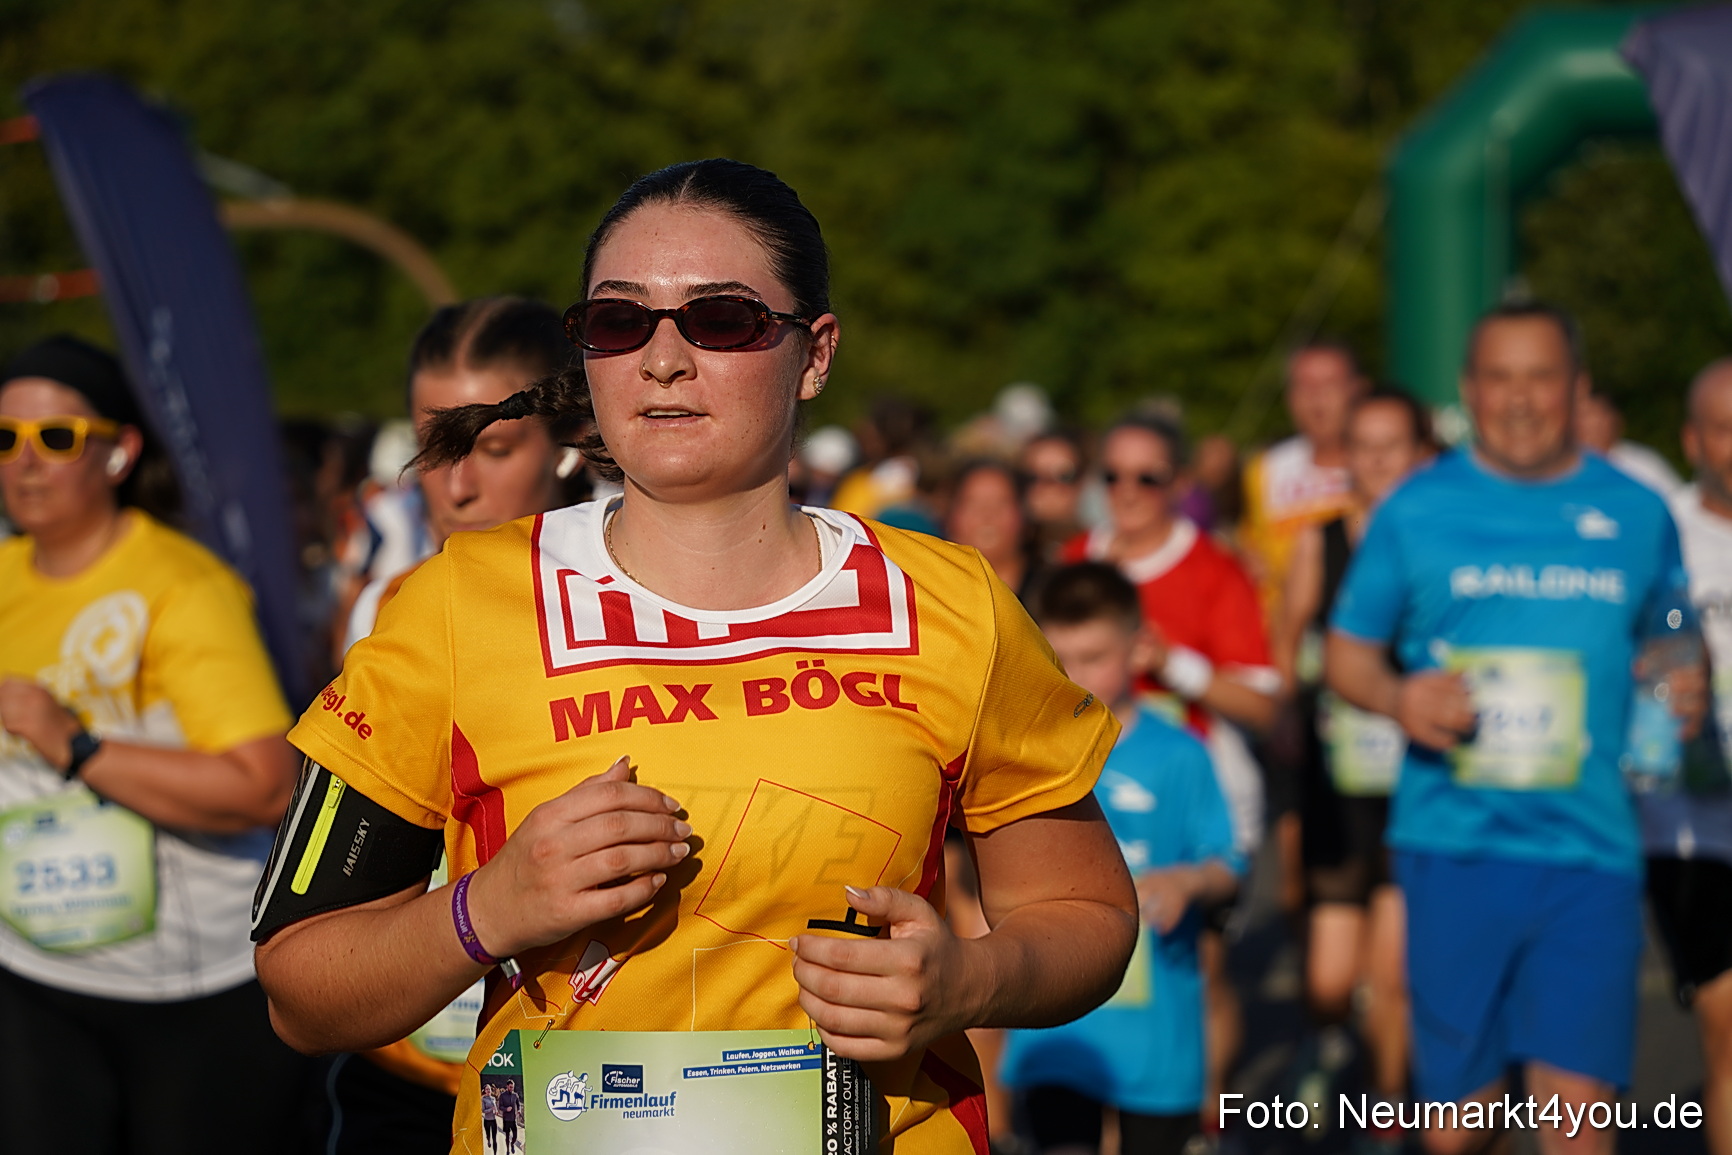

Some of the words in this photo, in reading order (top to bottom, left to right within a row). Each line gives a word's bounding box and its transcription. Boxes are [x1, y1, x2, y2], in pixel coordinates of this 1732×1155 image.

[549, 684, 719, 742] MAX
[742, 659, 919, 717] BÖGL
[343, 817, 370, 877] HAISSKY
[15, 853, 118, 896] 2533
[726, 1051, 751, 1060] Laufen,
[751, 1050, 777, 1059] Joggen,
[778, 1048, 804, 1057] Walken
[687, 1069, 709, 1077] Essen,
[710, 1067, 736, 1075] Trinken,
[761, 1063, 801, 1072] Netzwerken
[609, 1073, 641, 1085] Fischer
[826, 1047, 838, 1119] RABATT
[591, 1091, 676, 1109] Firmenlauf
[622, 1106, 675, 1119] neumarkt
[826, 1122, 838, 1136] %
